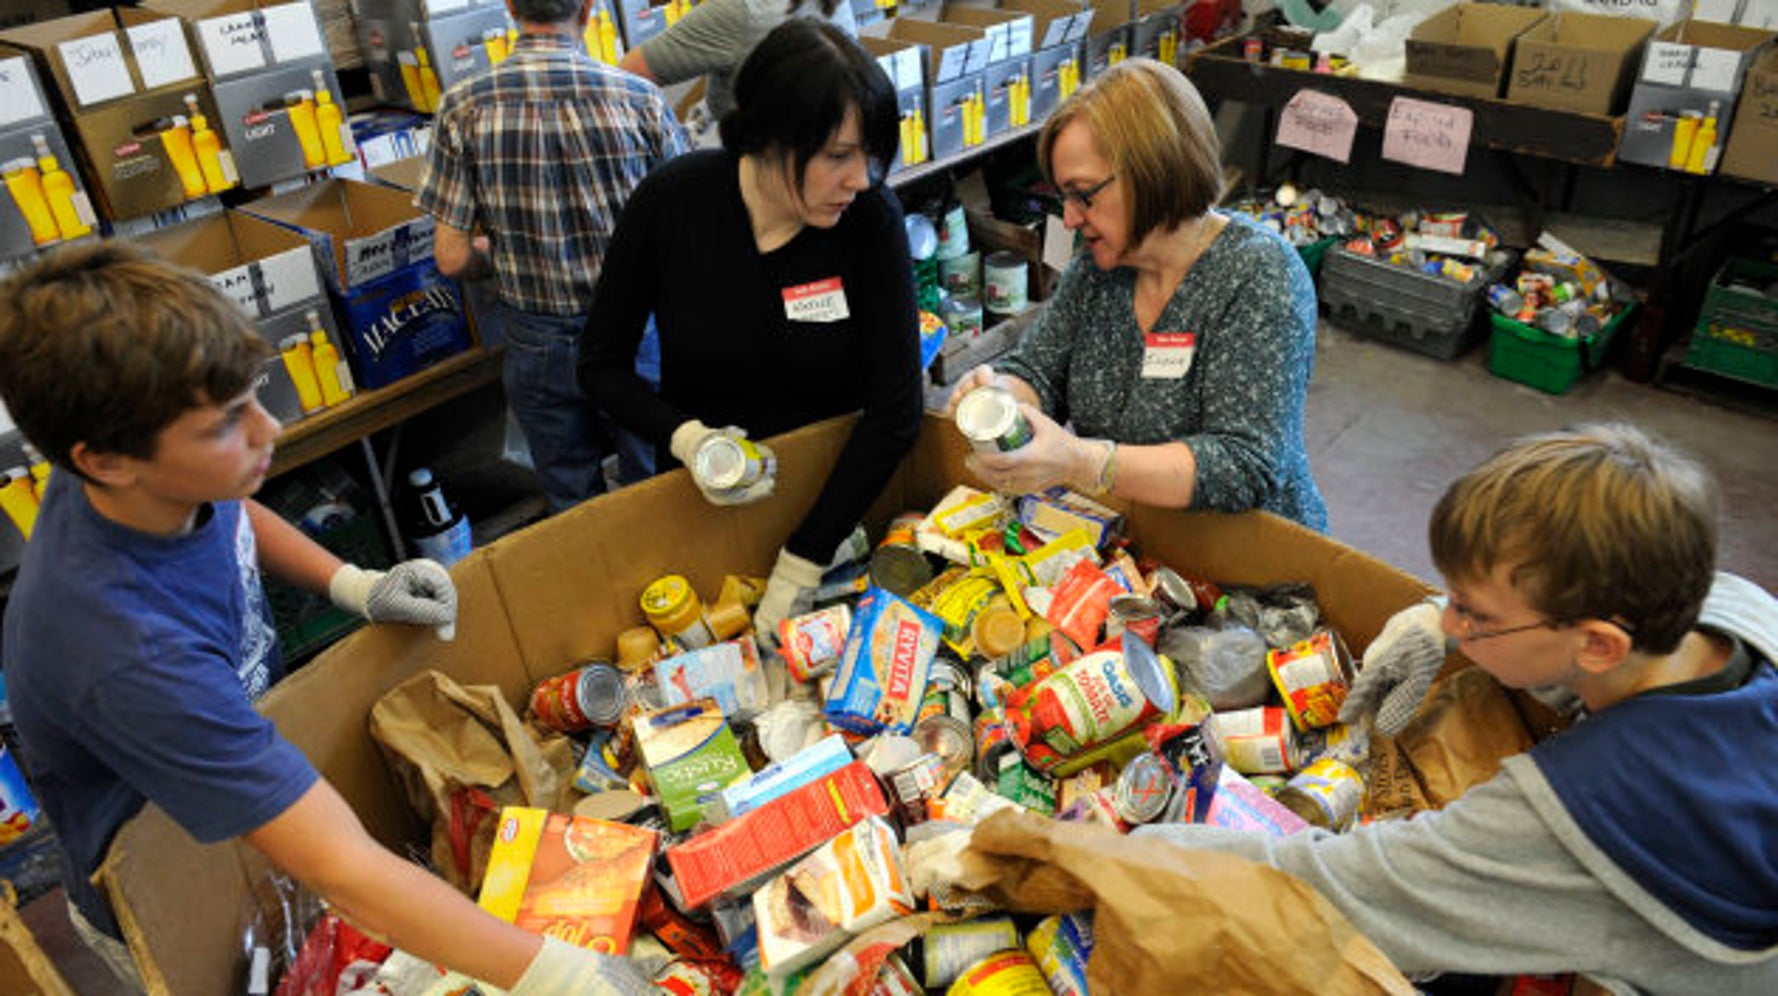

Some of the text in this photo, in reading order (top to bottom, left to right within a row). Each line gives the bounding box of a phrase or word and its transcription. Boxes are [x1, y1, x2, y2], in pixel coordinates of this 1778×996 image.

[891, 627, 915, 693] RYVITA
[1103, 660, 1132, 708] OASIS
[1075, 669, 1110, 723] TOMATE
